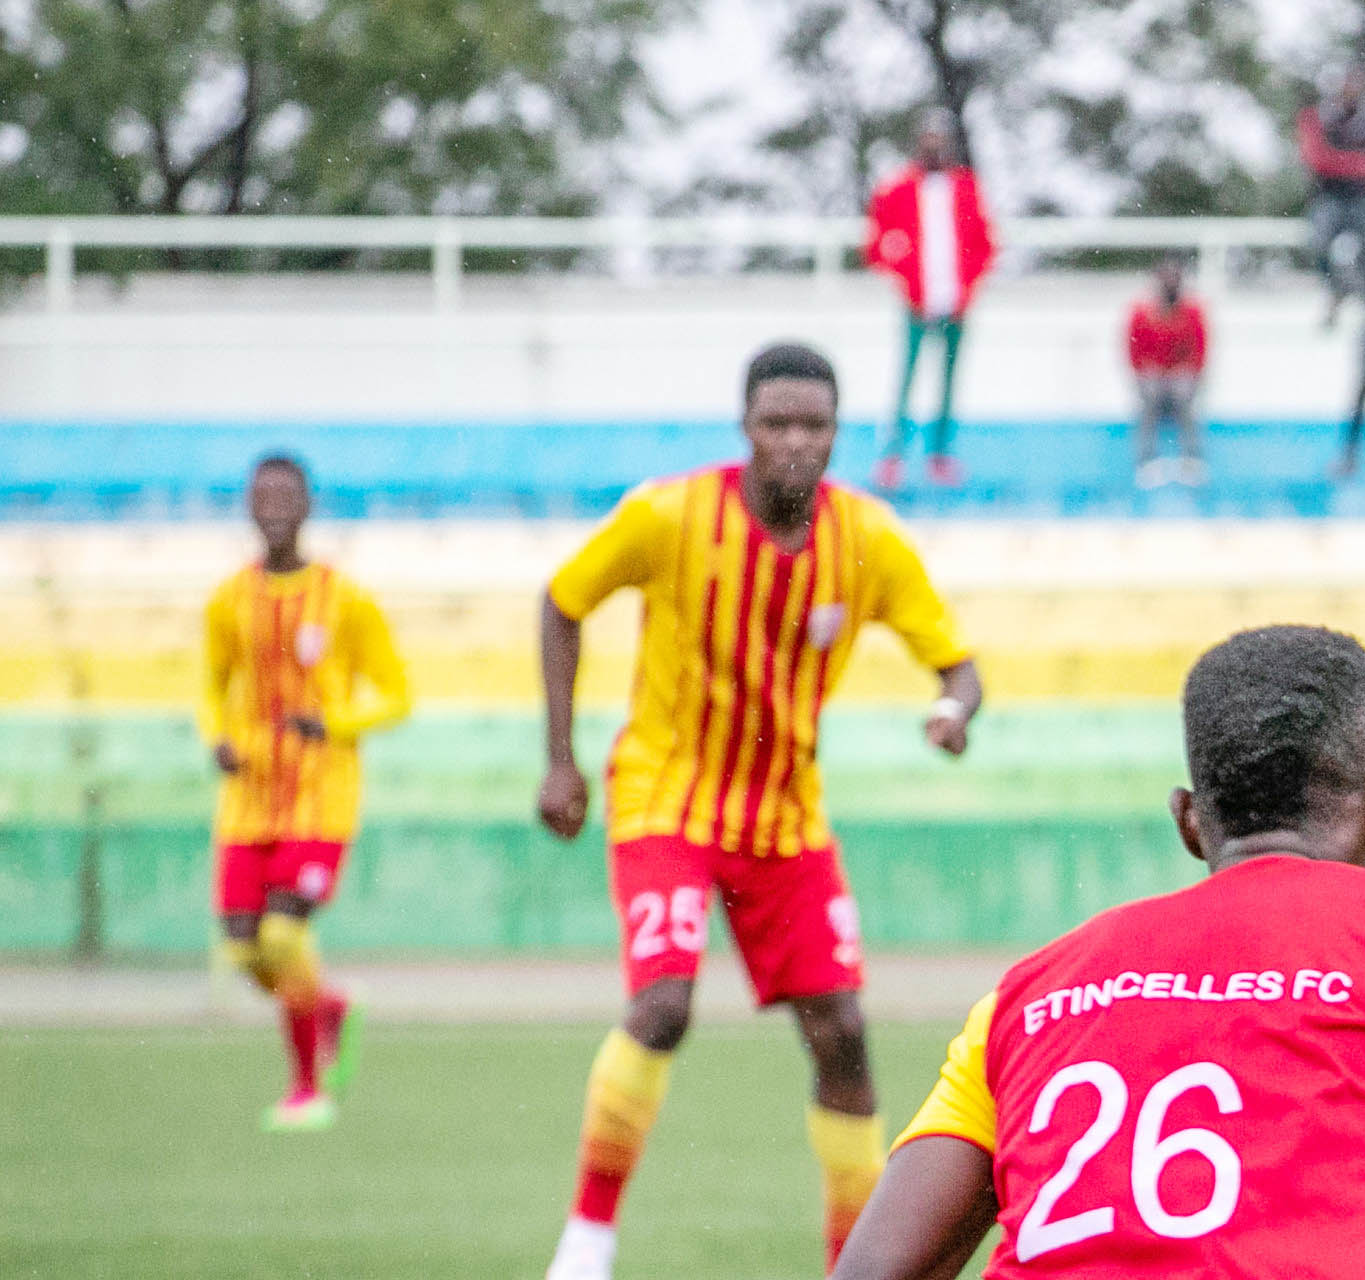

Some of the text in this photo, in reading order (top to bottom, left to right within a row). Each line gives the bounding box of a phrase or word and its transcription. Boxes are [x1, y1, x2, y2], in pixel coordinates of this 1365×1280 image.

[1023, 970, 1353, 1035] ETINCELLES FC
[1016, 1060, 1243, 1263] 26
